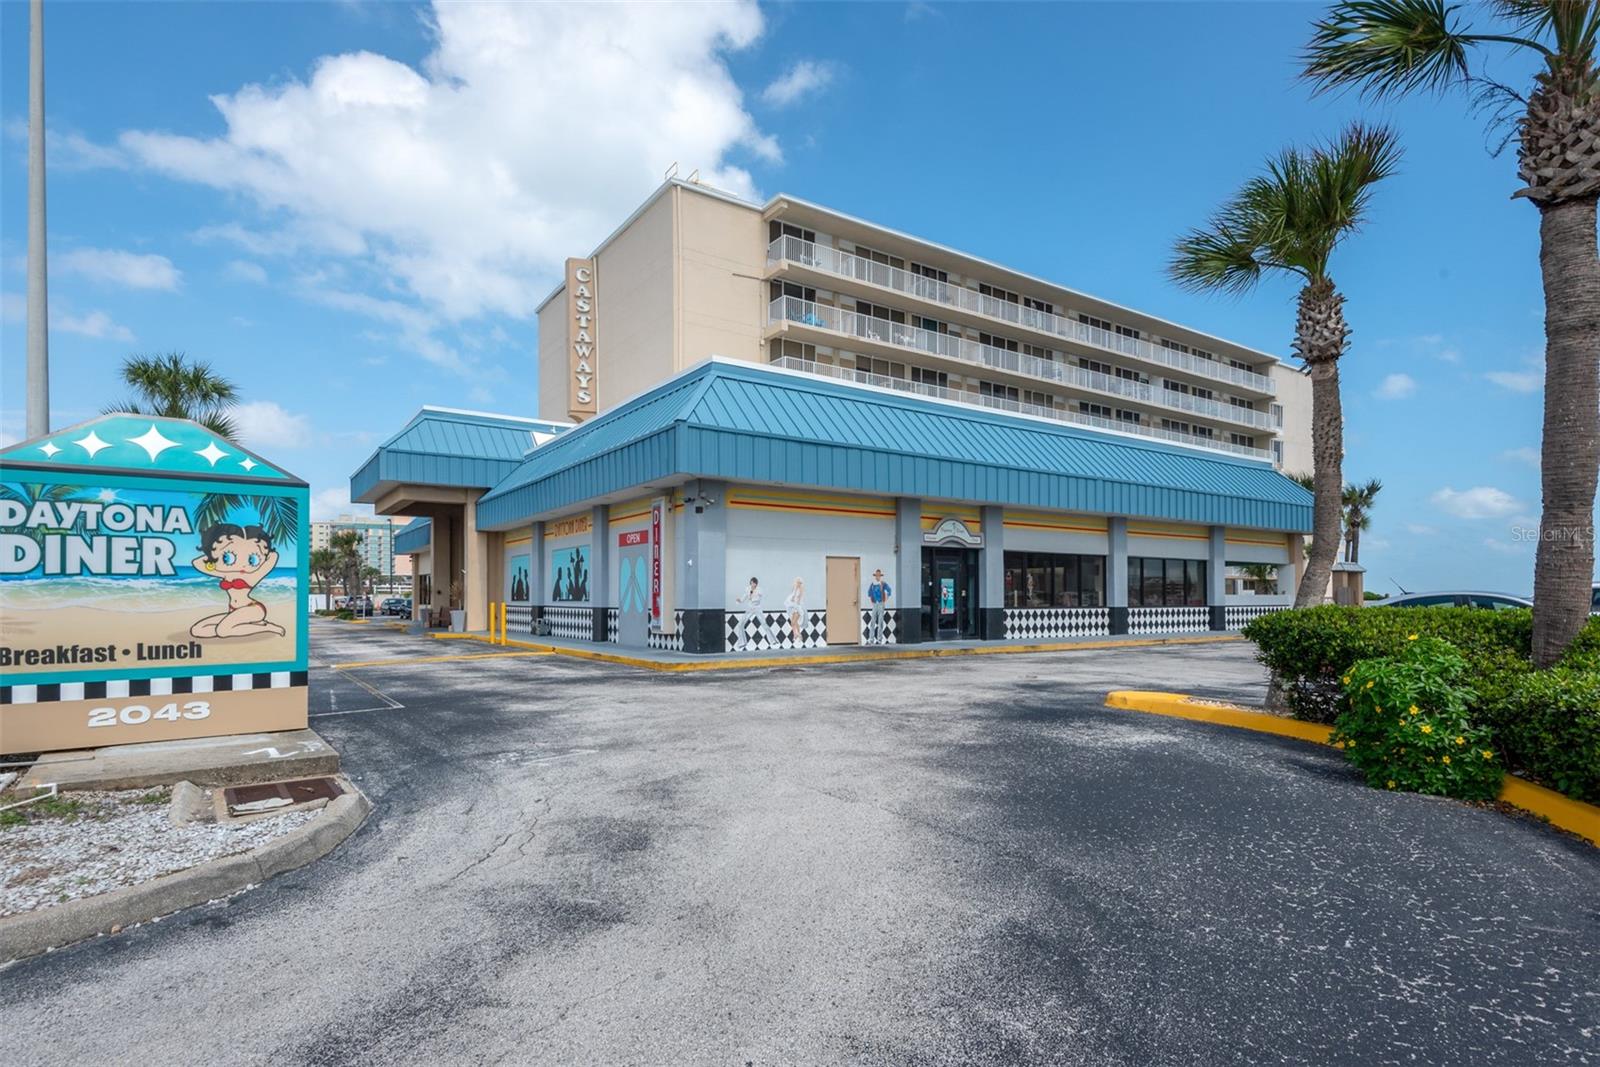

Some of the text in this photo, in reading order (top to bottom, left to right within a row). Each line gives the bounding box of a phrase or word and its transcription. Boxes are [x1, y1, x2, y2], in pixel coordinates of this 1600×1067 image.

[573, 267, 594, 405] CASTAWAYS
[0, 499, 192, 534] DAYTONA
[626, 533, 641, 544] OPEN
[0, 533, 176, 575] DINER
[0, 641, 202, 666] Breakfast Lunch
[87, 702, 210, 727] 2043
